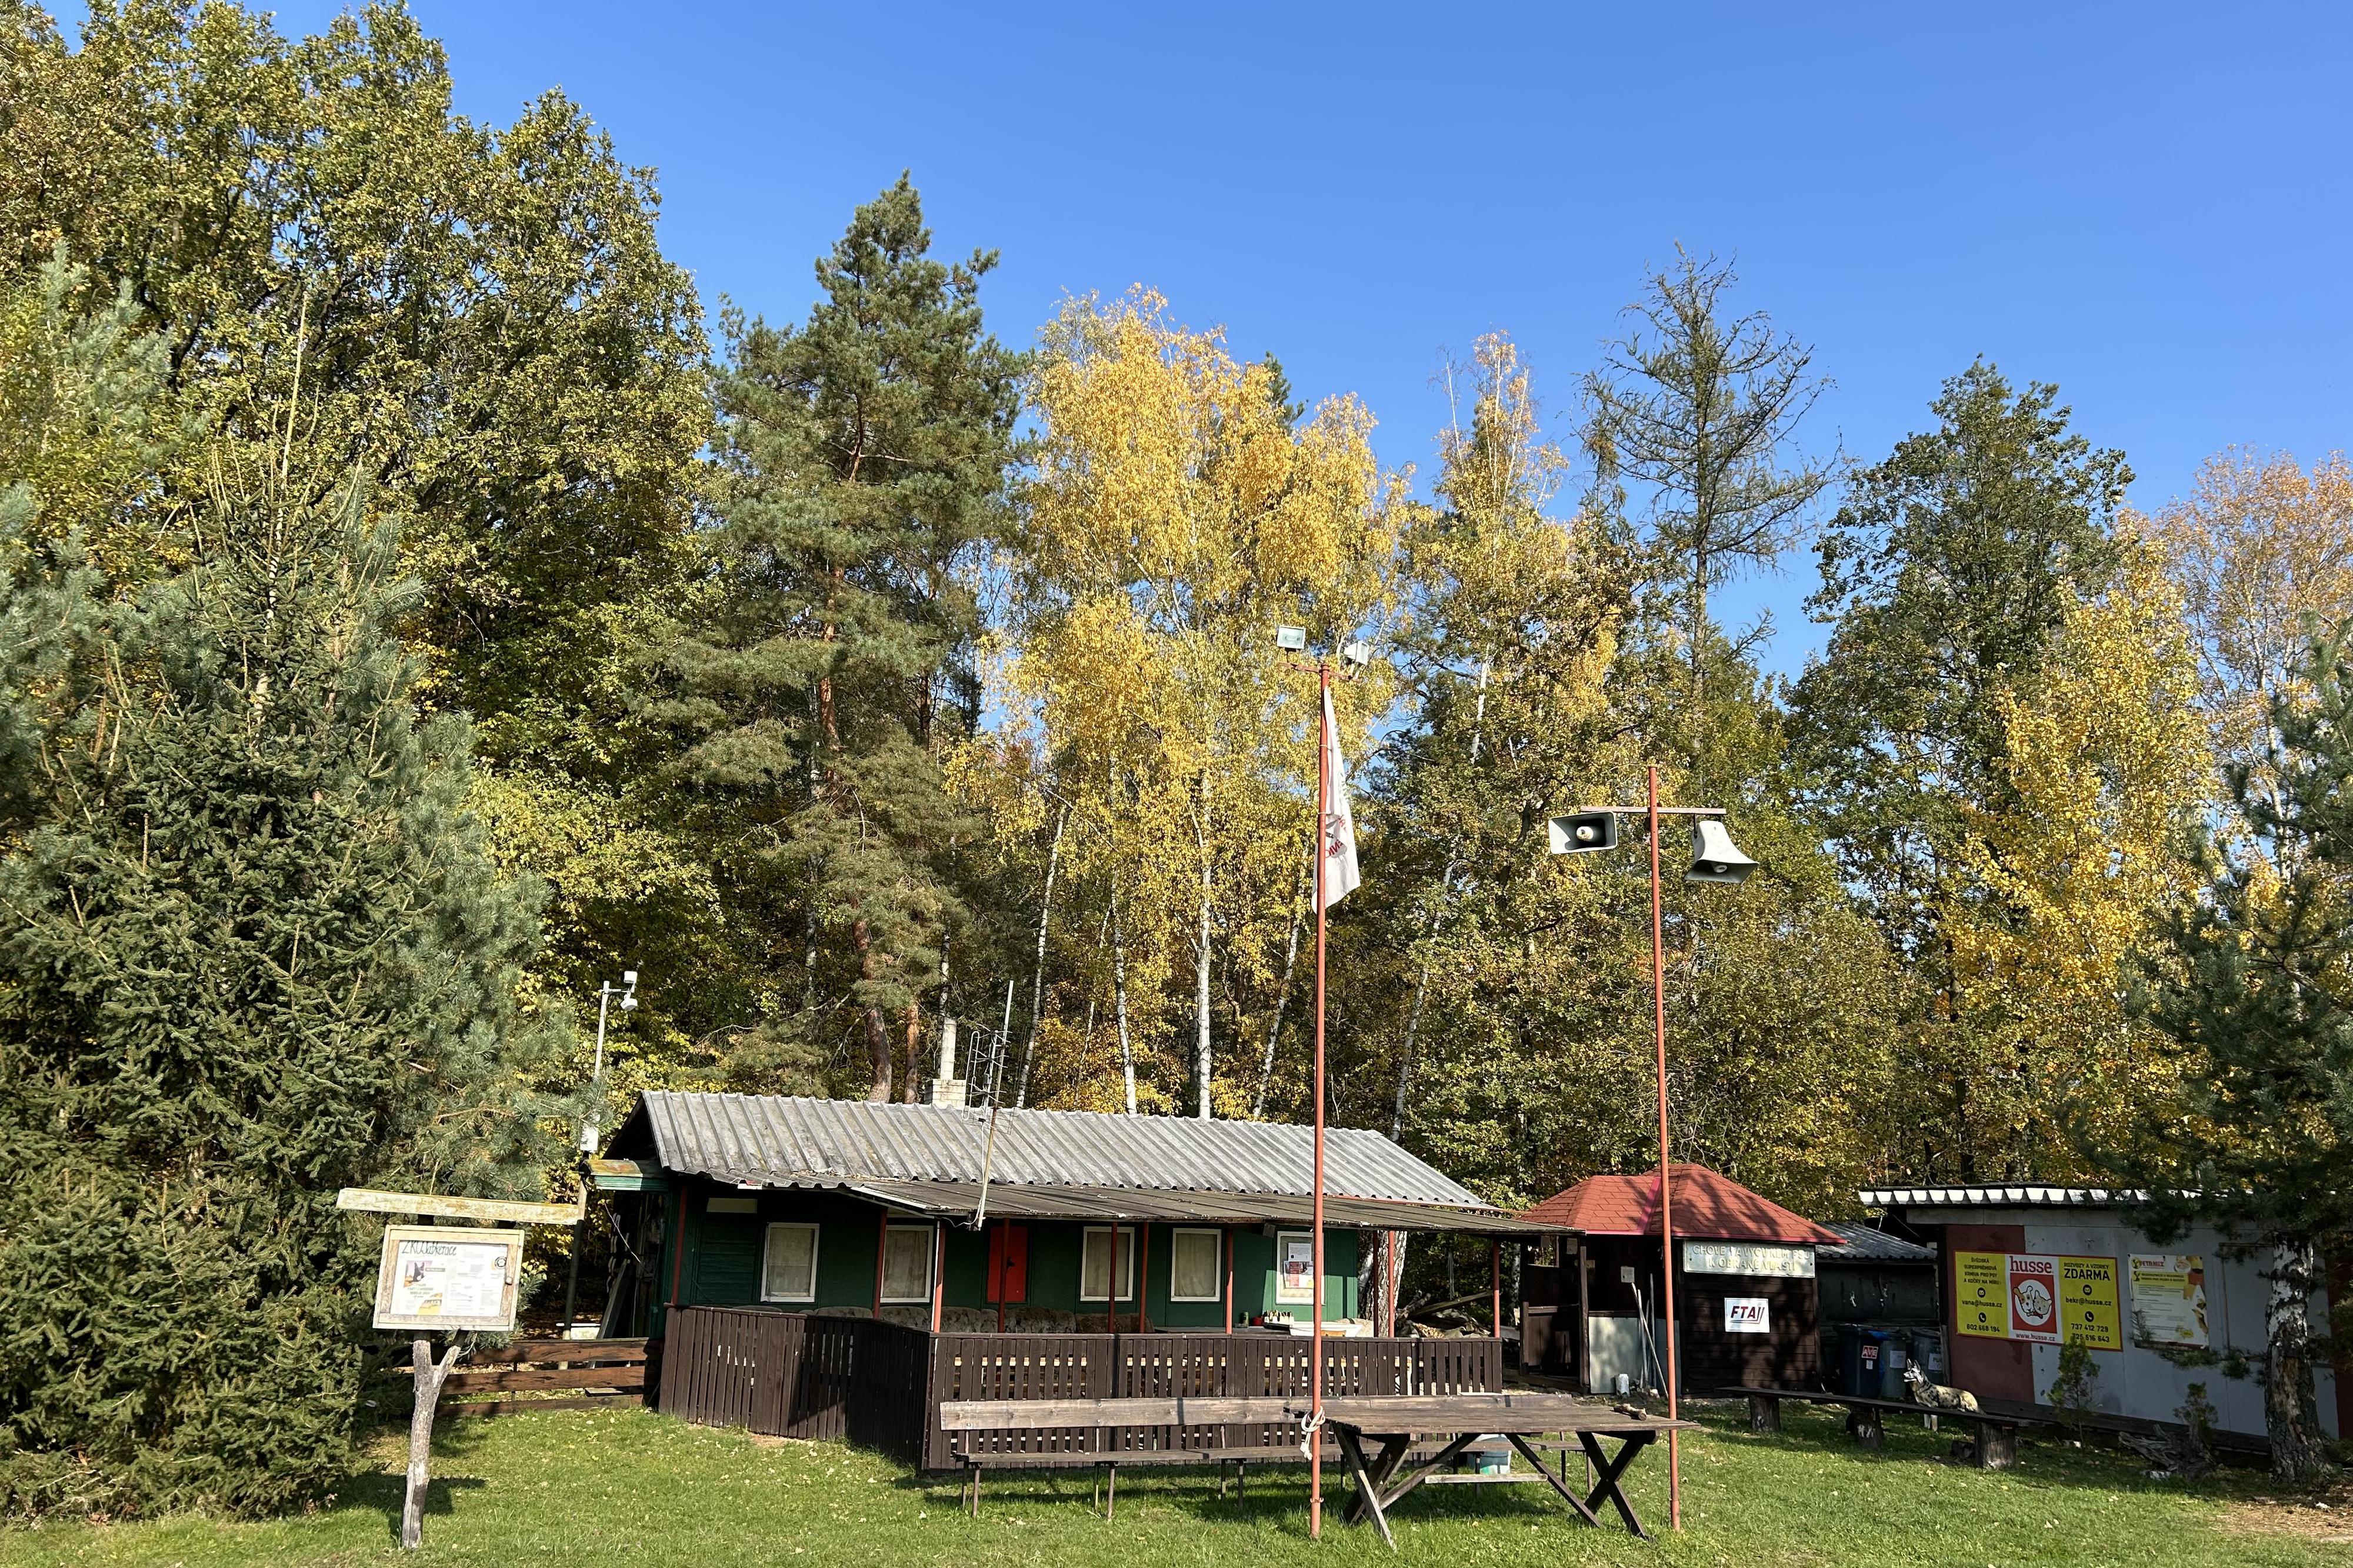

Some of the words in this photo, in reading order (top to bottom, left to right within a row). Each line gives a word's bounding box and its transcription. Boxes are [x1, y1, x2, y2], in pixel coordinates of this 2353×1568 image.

[2009, 1256, 2052, 1274] husse
[2064, 1267, 2111, 1281] ZDARMA
[2065, 1296, 2112, 1306] bekr@husse.cz
[2015, 1333, 2056, 1342] www.husse.cz
